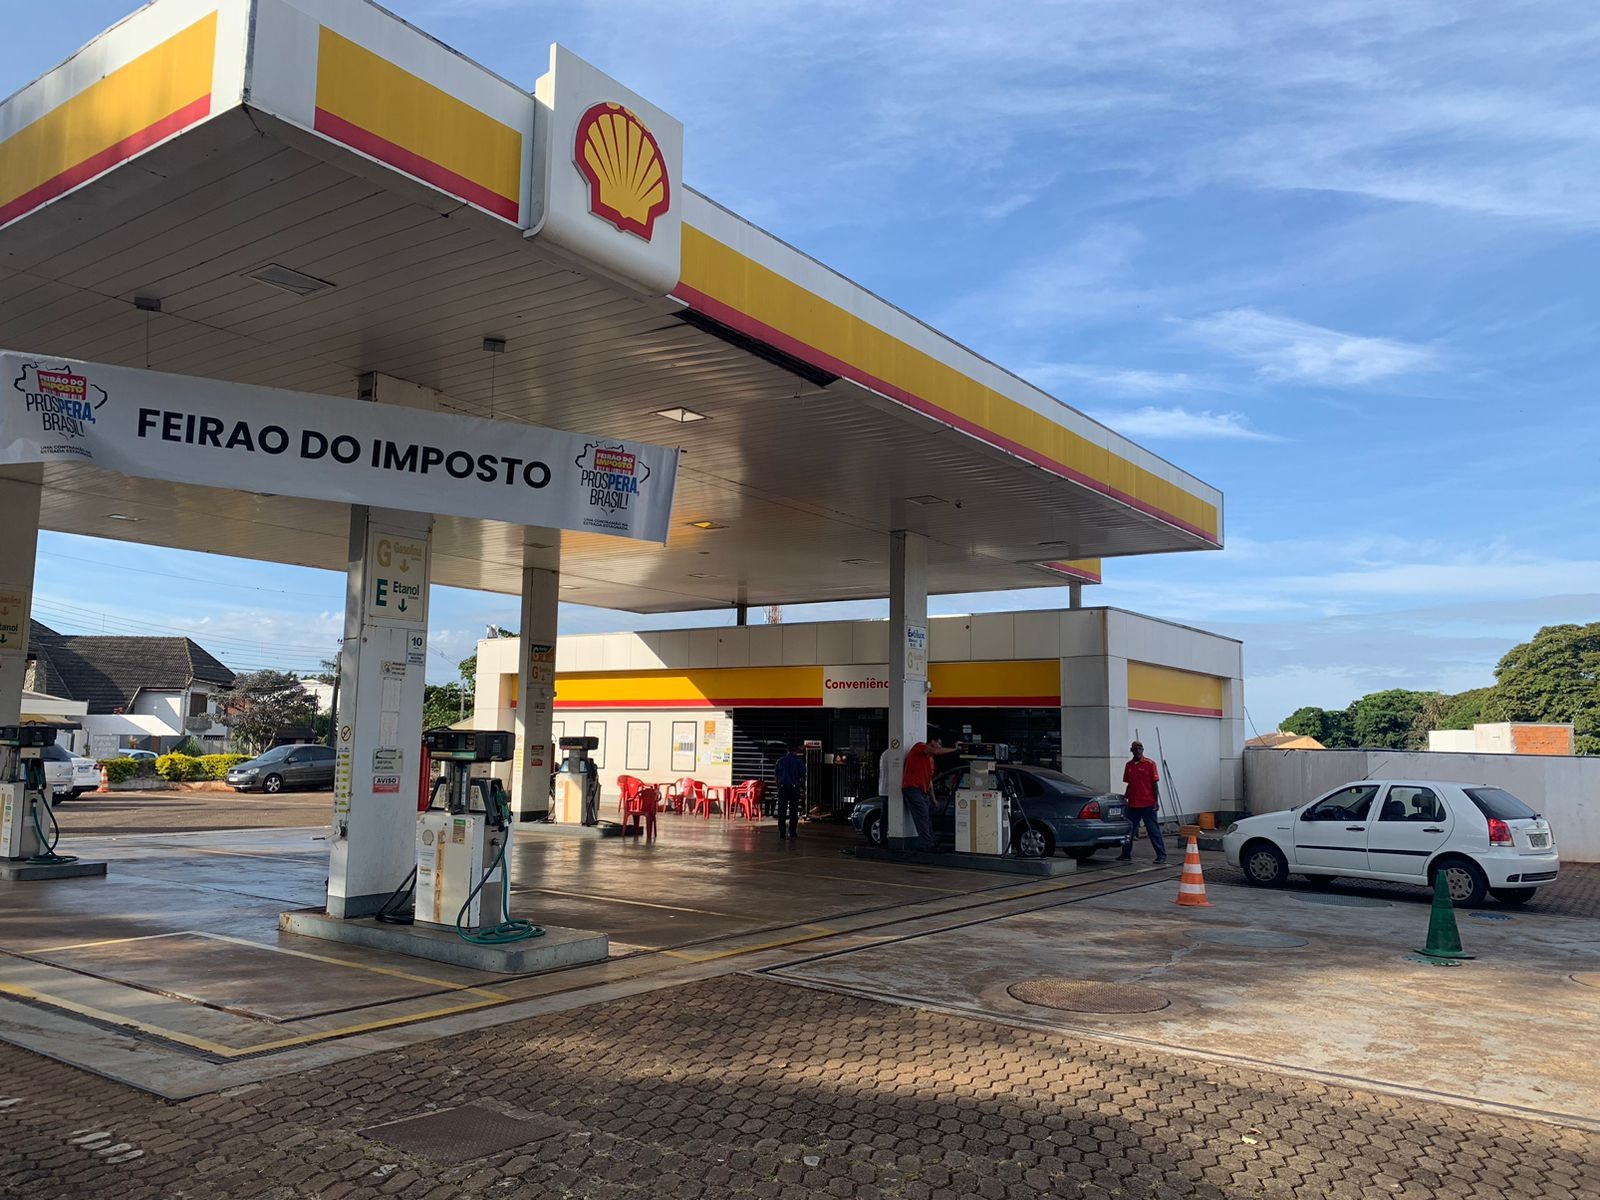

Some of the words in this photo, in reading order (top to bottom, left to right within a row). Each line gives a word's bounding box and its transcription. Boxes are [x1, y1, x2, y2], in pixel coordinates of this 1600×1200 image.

[70, 379, 84, 387] DO
[25, 393, 96, 424] PROSPERA,
[42, 413, 85, 437] BRASIL!
[138, 408, 289, 454] FEIRAO
[300, 430, 361, 463] DO
[371, 439, 551, 489] IMPOSTO
[595, 459, 633, 469] IMPOSTO
[581, 469, 640, 496] PROSPERA,
[590, 488, 629, 510] BRASIL!
[377, 540, 391, 567] G
[376, 578, 388, 606] E
[393, 581, 419, 596] Etanol
[411, 637, 423, 646] 10
[907, 652, 914, 669] G
[532, 666, 538, 679] G
[377, 777, 397, 785] AVISO
